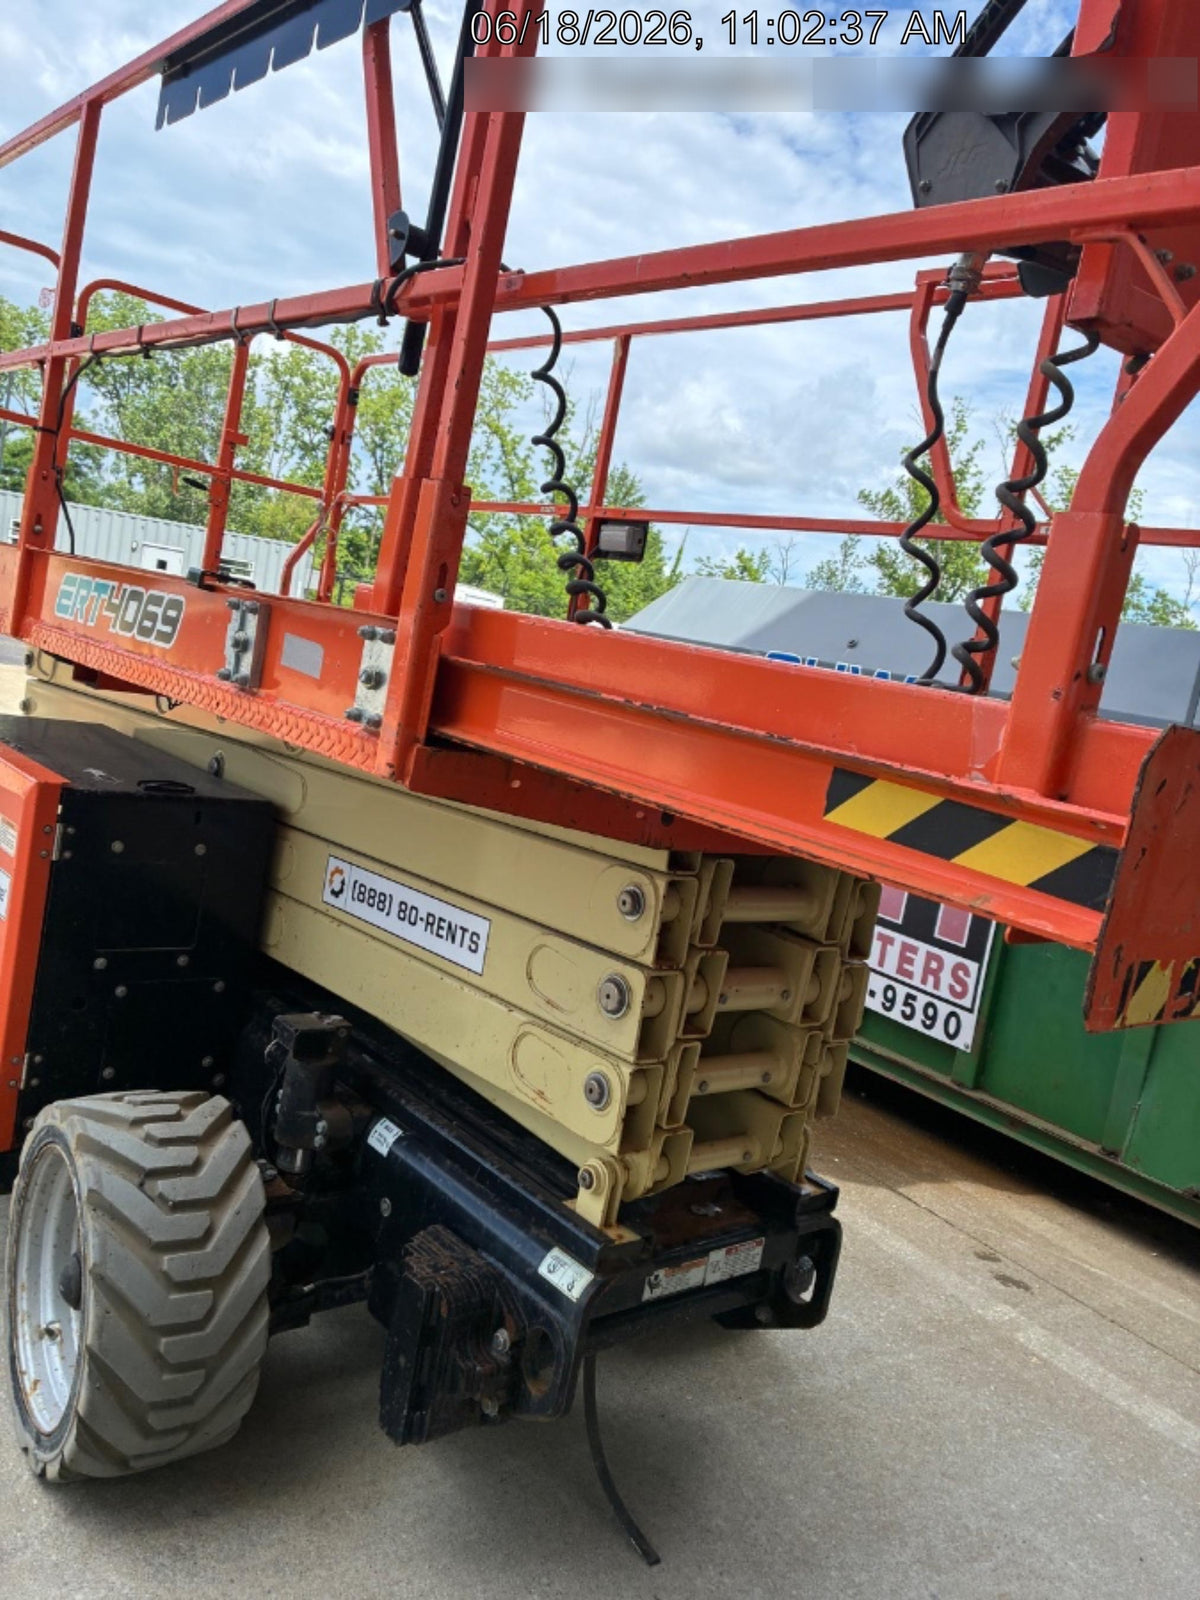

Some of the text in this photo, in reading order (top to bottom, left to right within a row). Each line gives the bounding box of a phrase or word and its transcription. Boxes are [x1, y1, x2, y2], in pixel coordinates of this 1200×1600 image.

[54, 572, 186, 650] ERT4069
[351, 879, 480, 954] (888) 80-RENTS
[876, 931, 972, 1001] TERS
[868, 984, 962, 1041] -9590
